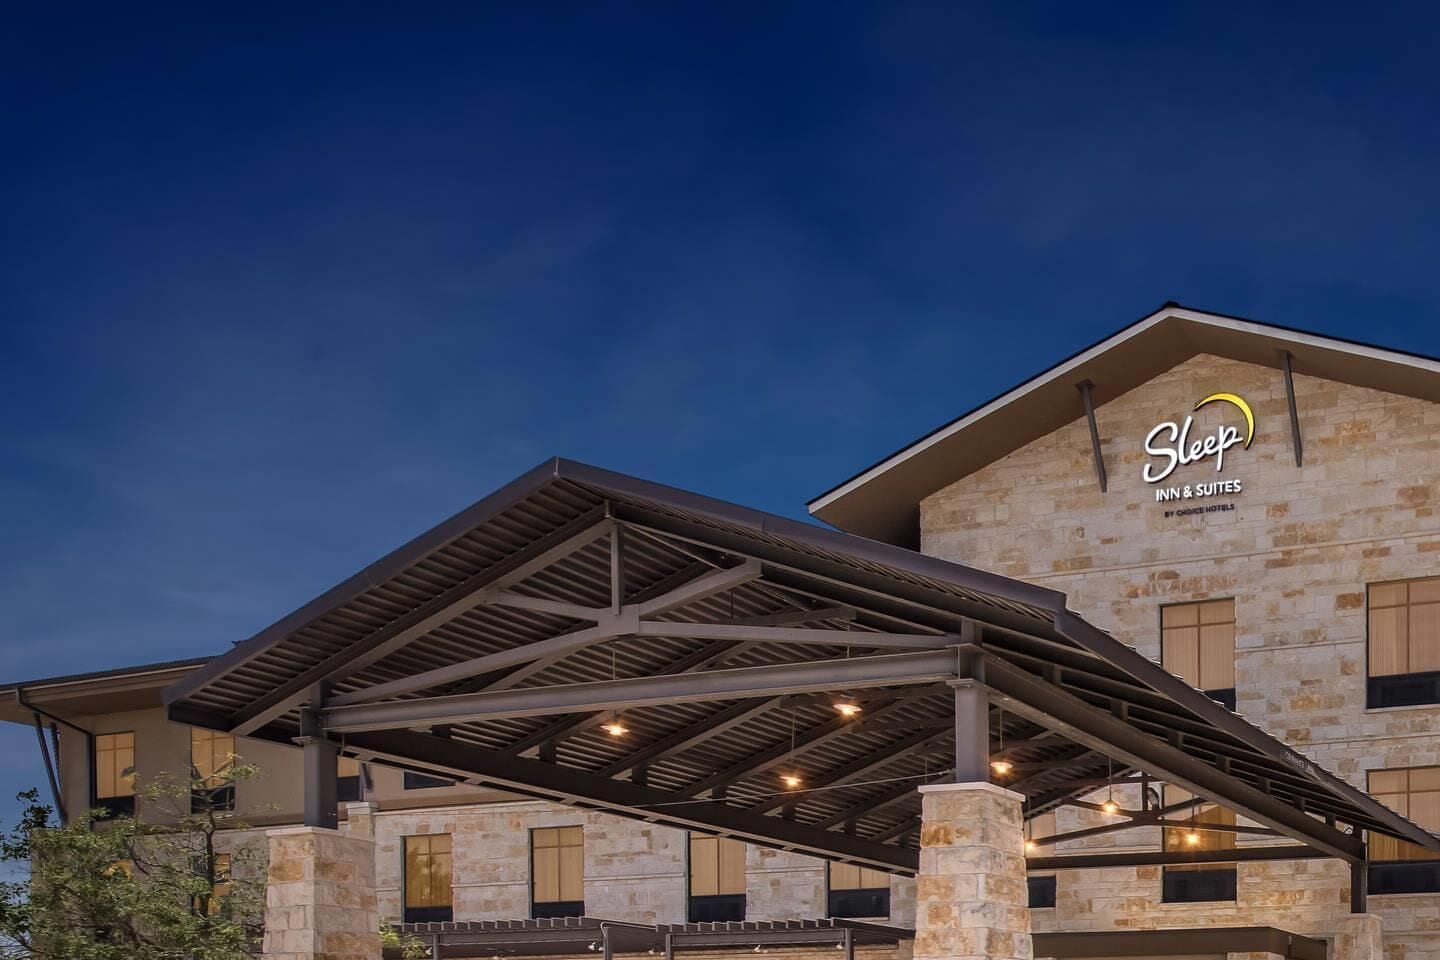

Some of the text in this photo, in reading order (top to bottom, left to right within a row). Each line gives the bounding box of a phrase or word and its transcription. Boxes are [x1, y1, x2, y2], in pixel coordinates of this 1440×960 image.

[1143, 415, 1244, 482] Sleep
[1156, 480, 1242, 502] INN & SUITES
[1176, 506, 1204, 517] CHOICE
[1205, 504, 1235, 513] HOTELS
